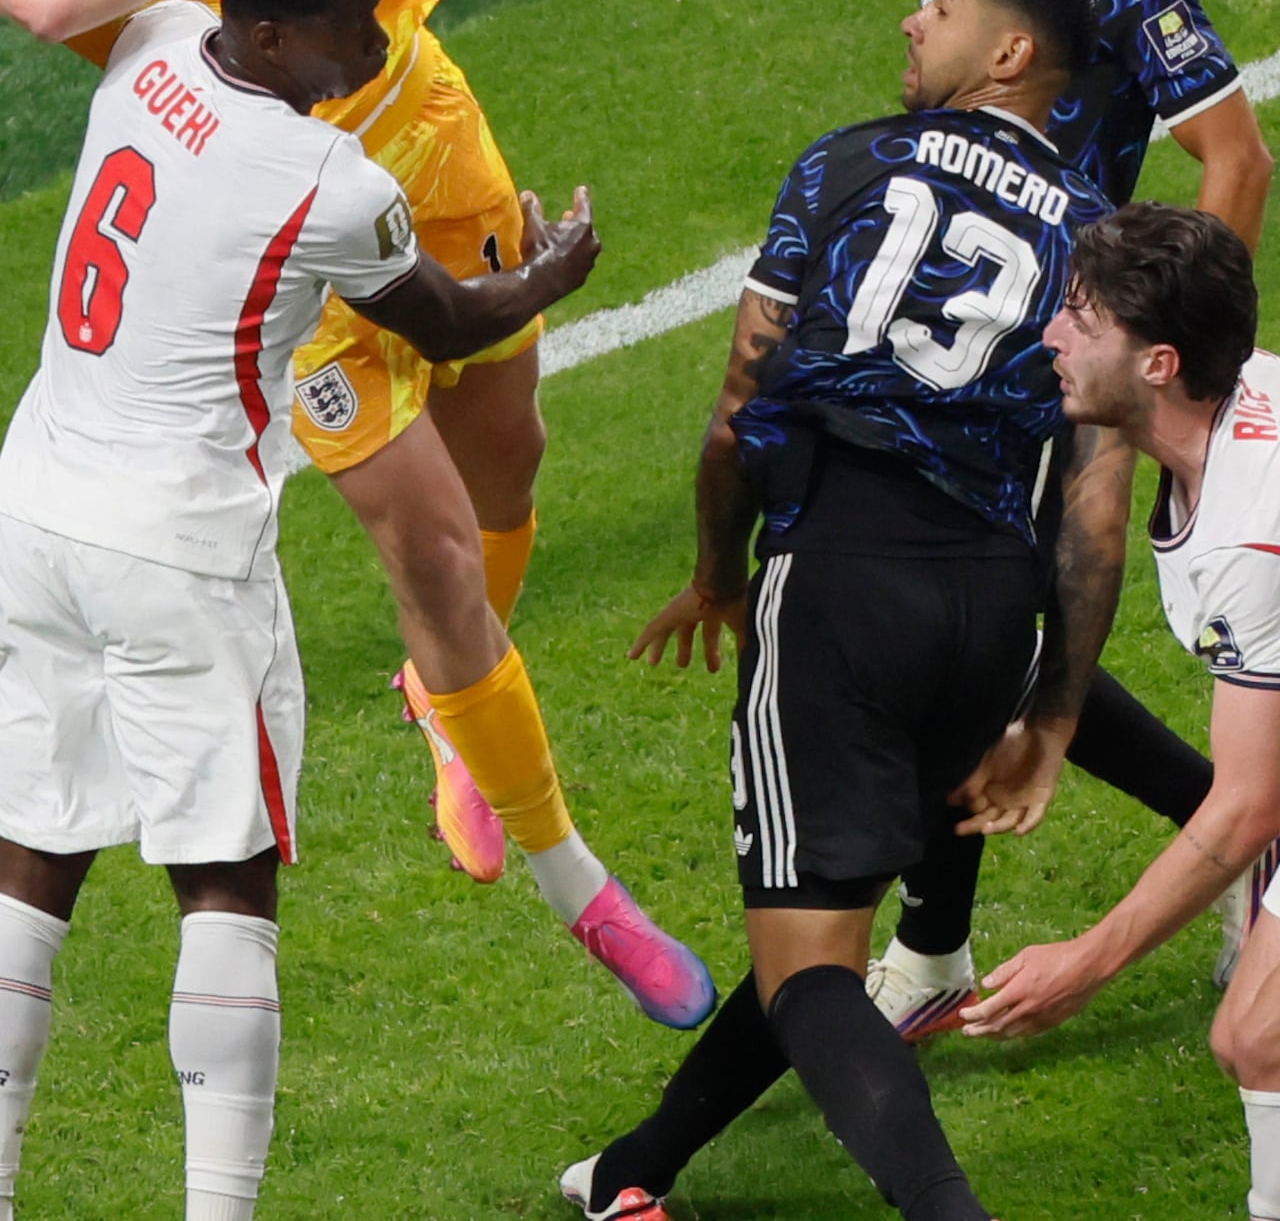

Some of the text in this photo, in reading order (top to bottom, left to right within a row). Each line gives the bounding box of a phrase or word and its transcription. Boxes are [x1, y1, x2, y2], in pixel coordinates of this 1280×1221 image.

[57, 145, 156, 357] 6
[481, 232, 501, 273] 1
[916, 131, 1069, 226] ROMERO
[842, 177, 1041, 392] 13
